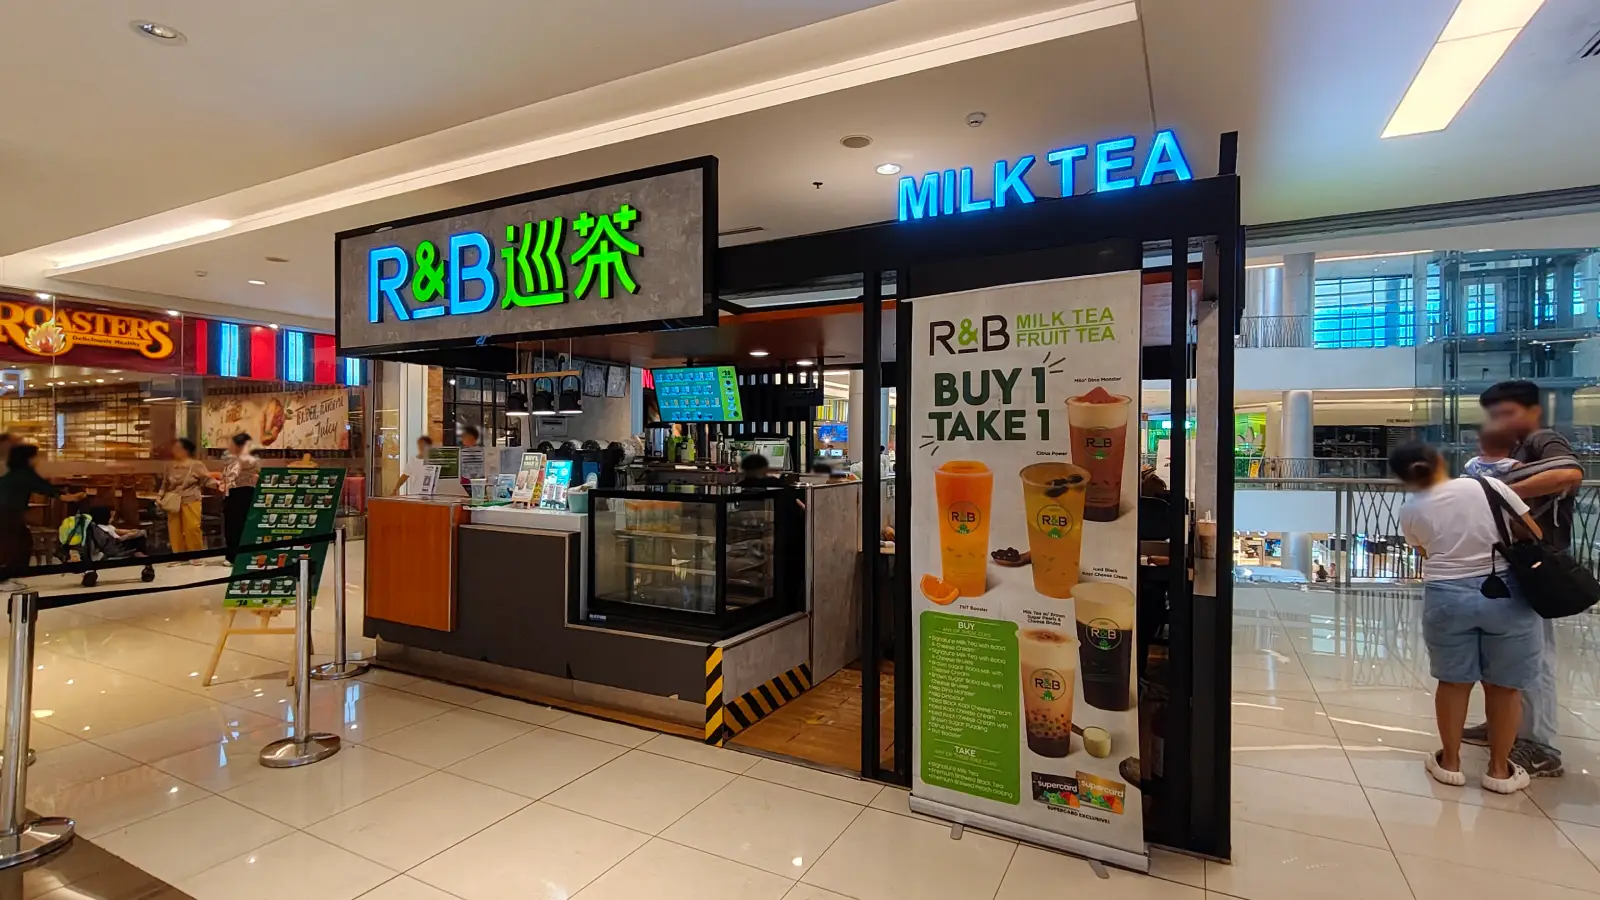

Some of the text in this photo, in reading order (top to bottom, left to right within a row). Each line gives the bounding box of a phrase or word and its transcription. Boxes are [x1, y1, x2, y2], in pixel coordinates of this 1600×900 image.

[899, 129, 1192, 221] MILK TEA
[369, 204, 640, 322] R&B 巡茶
[1016, 307, 1114, 329] MILK TEA
[0, 302, 174, 359] ROASTERS
[72, 335, 141, 347] Deliciously Healthy
[929, 315, 1010, 356] R&B
[1016, 326, 1115, 347] FRUIT TEA
[934, 367, 1045, 407] BUY 1
[928, 409, 1050, 441] TAKE 1
[957, 621, 975, 630] BUY
[1091, 628, 1116, 640] R&B
[954, 746, 976, 757] TAKE
[1038, 780, 1078, 793] supercard
[1081, 780, 1124, 798] supercard
